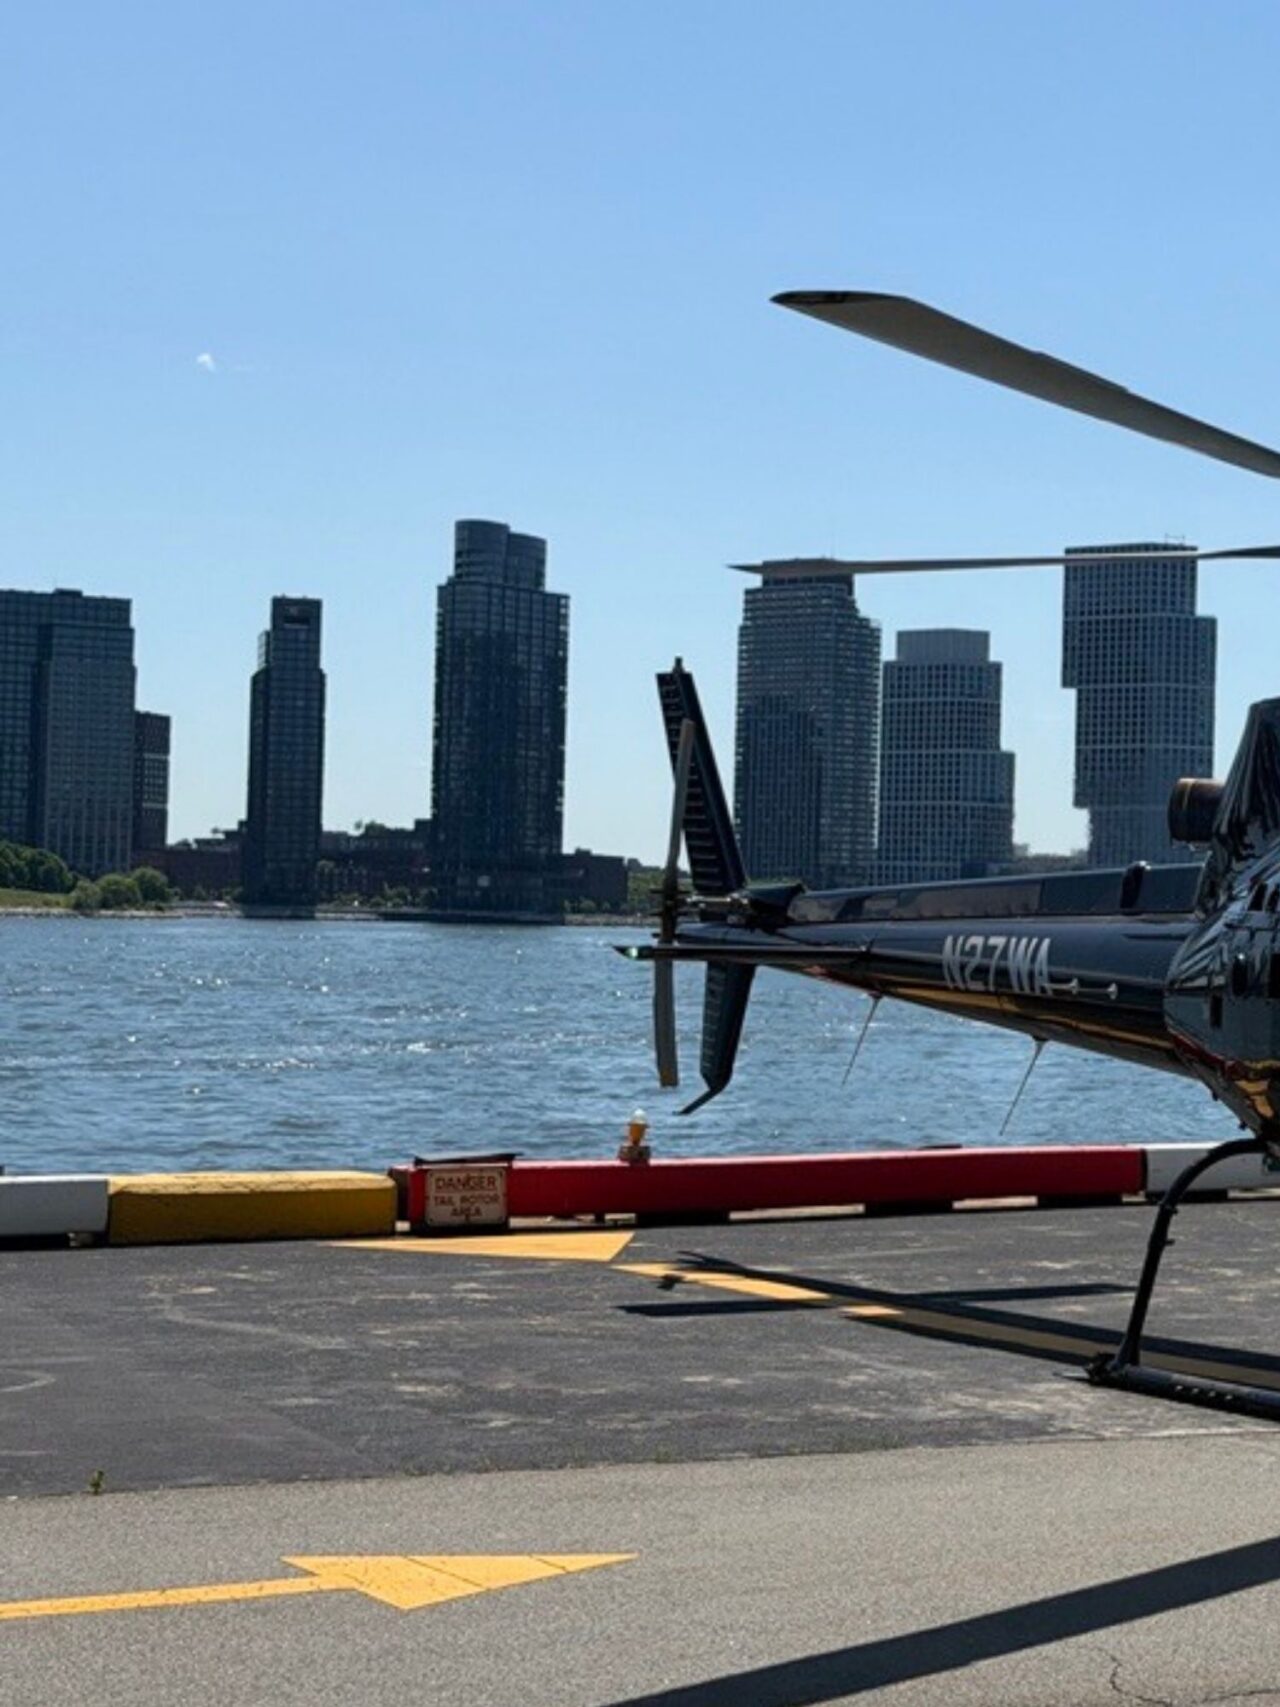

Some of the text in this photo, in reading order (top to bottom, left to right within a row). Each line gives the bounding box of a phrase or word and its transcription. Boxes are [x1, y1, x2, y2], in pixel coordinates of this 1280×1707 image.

[942, 935, 1053, 996] N27WA
[435, 1175, 497, 1190] DANGER
[434, 1194, 500, 1207] TAIL ROTOR
[451, 1206, 483, 1217] AREA
